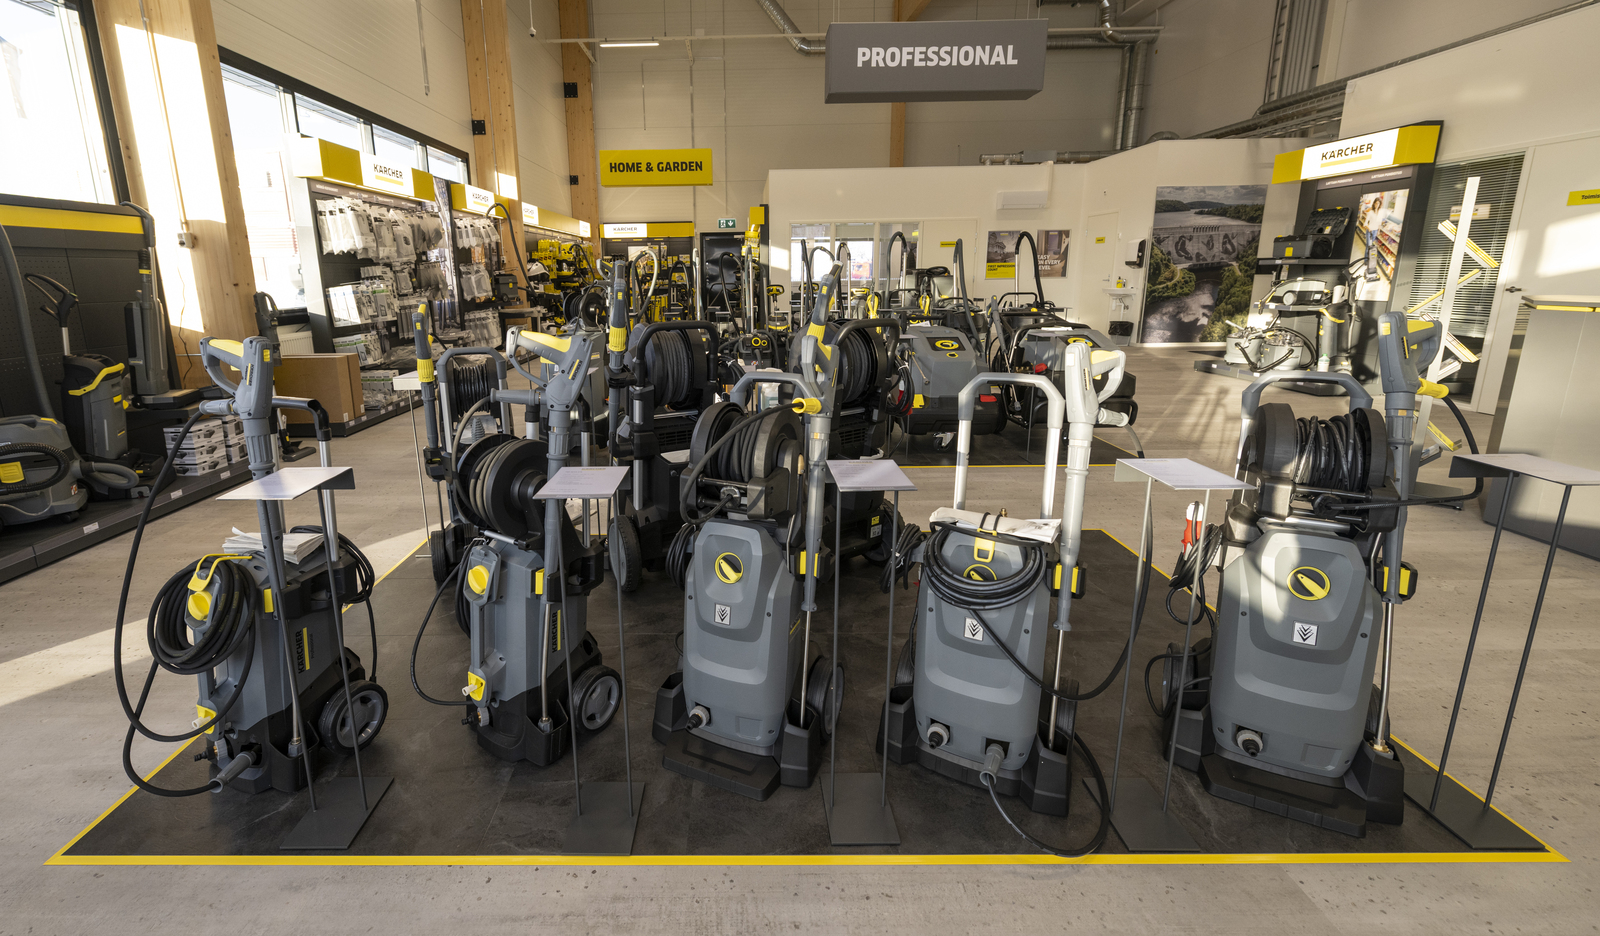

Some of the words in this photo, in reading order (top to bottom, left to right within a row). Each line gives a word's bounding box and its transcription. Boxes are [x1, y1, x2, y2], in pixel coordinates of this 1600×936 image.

[856, 44, 1019, 68] PROFESSIONAL
[609, 162, 643, 173] HOME
[645, 162, 654, 173] &
[656, 161, 703, 172] GARDEN
[296, 630, 305, 674] KÄRCHER
